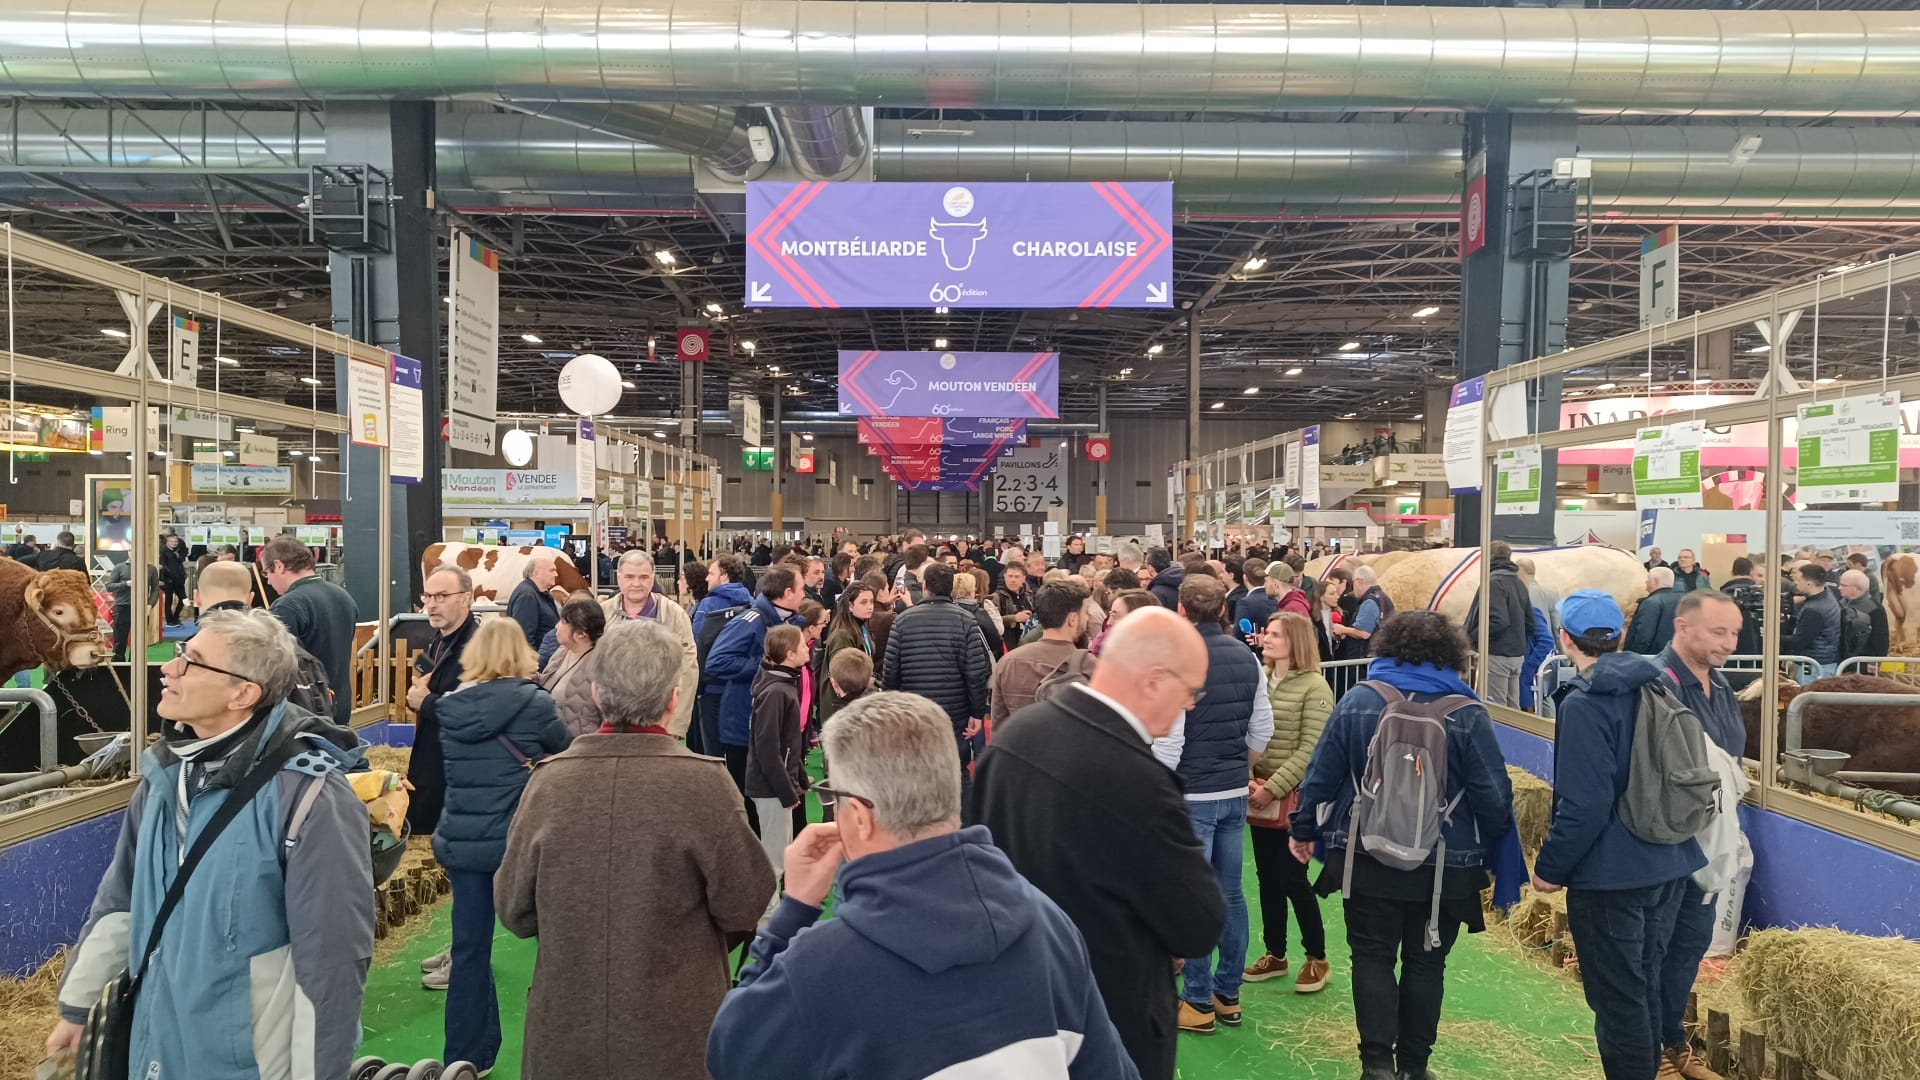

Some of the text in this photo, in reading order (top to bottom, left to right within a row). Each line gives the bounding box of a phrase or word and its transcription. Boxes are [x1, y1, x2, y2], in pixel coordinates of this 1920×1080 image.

[781, 236, 927, 256] MONTBÉLIARDE
[1012, 241, 1137, 257] CHAROLAISE
[1651, 259, 1667, 309] F
[962, 288, 988, 297] édition
[181, 338, 191, 370] E
[928, 379, 1037, 392] MOUTON VENDÉEN
[106, 425, 128, 437] Ring
[1603, 466, 1624, 476] Ring
[449, 473, 496, 485] Mouton
[450, 484, 496, 492] Vendéen
[1726, 877, 1737, 919] RAGT
